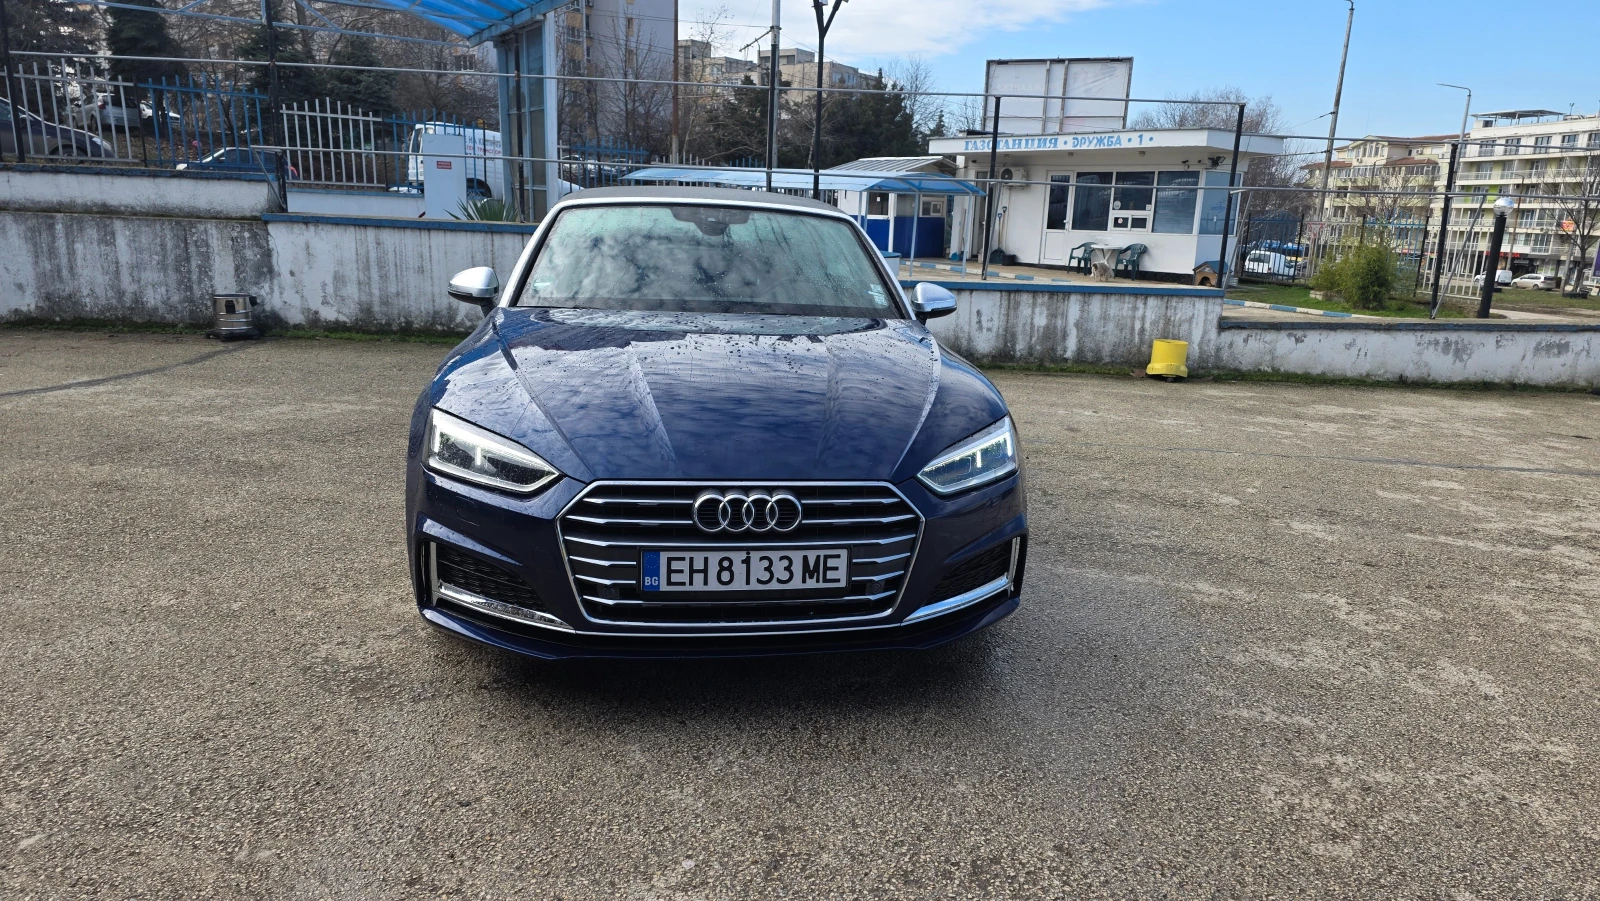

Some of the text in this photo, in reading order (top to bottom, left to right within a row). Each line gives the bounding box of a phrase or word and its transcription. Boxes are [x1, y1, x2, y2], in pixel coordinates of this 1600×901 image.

[1072, 135, 1122, 148] ДРУЖБА
[1138, 134, 1143, 145] 1
[644, 576, 659, 586] BG
